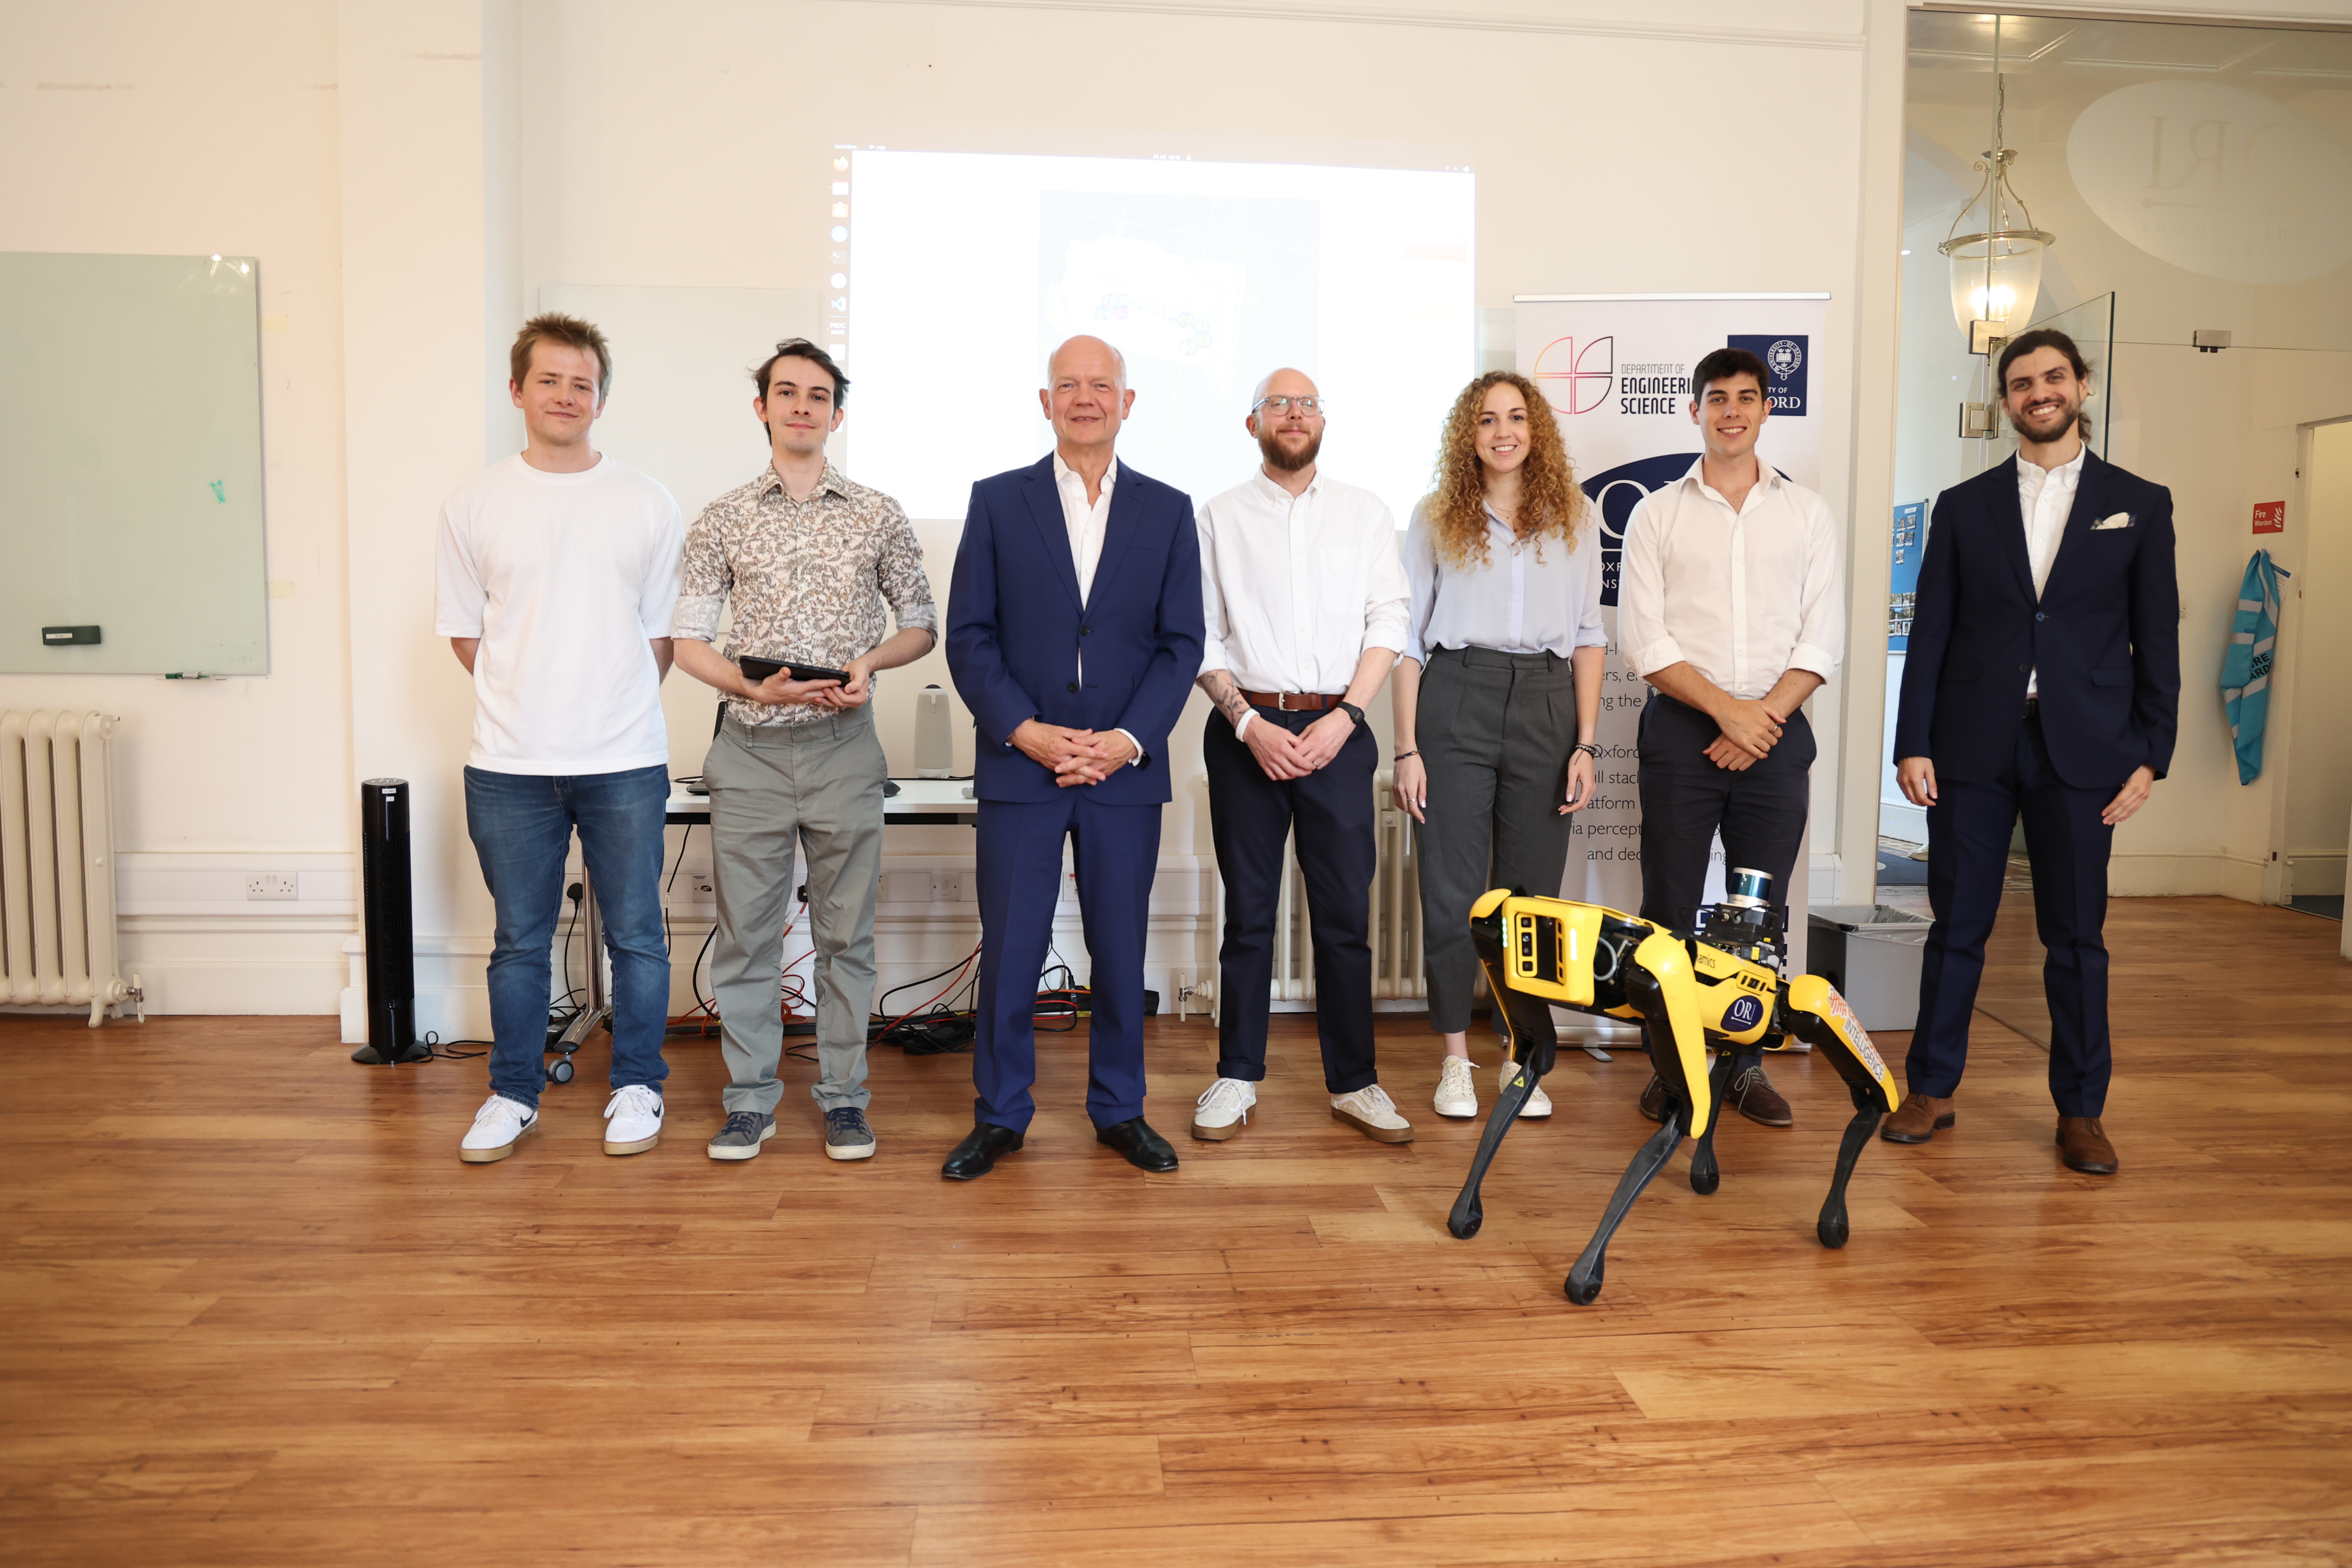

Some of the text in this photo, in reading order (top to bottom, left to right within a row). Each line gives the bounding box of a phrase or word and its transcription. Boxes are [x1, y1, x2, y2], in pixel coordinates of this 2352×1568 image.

[1769, 341, 1783, 367] UNIVERSITY
[1622, 364, 1684, 374] DEPARTMENT OF
[1621, 398, 1675, 414] SCIENCE
[2255, 510, 2266, 518] Fire
[1617, 693, 1641, 707] the
[1587, 847, 1613, 861] and
[1845, 1017, 1883, 1081] INTELLIGENCE
